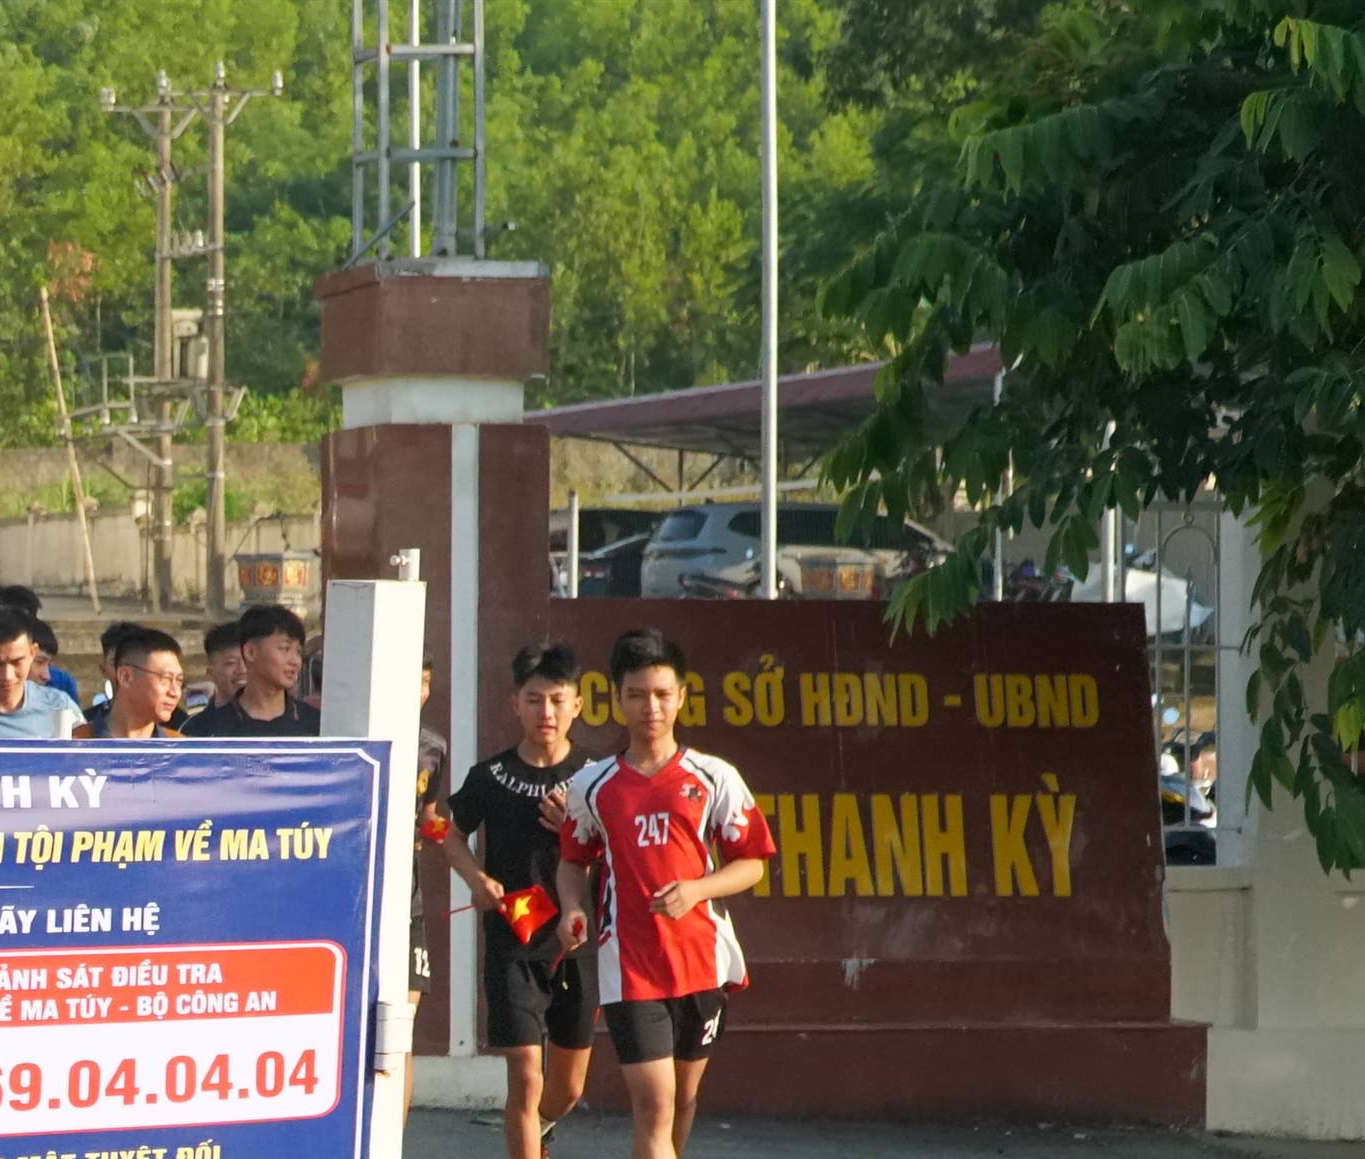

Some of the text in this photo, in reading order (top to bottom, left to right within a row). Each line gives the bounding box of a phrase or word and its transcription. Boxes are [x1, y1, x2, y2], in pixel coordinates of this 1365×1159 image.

[723, 654, 785, 728] SỞ
[799, 672, 930, 728] HĐND
[974, 672, 1101, 729] UBND
[50, 767, 108, 809] KỲ
[14, 824, 63, 870] TỘI
[71, 831, 165, 868] PHẠM
[176, 820, 212, 861] VỀ
[220, 830, 269, 860] MA
[277, 822, 333, 859] TÚY
[634, 812, 670, 848] 247
[990, 771, 1077, 898] KỲ
[47, 904, 111, 933] LIÊN
[122, 903, 159, 935] HỆ
[57, 963, 103, 988] SÁT
[111, 959, 168, 986] ĐIỀU
[176, 963, 222, 984] TRA
[21, 999, 58, 1020] MA
[66, 994, 112, 1018] TÚY
[137, 992, 168, 1019] BỘ
[176, 990, 238, 1014] CÔNG
[245, 991, 276, 1011] AN
